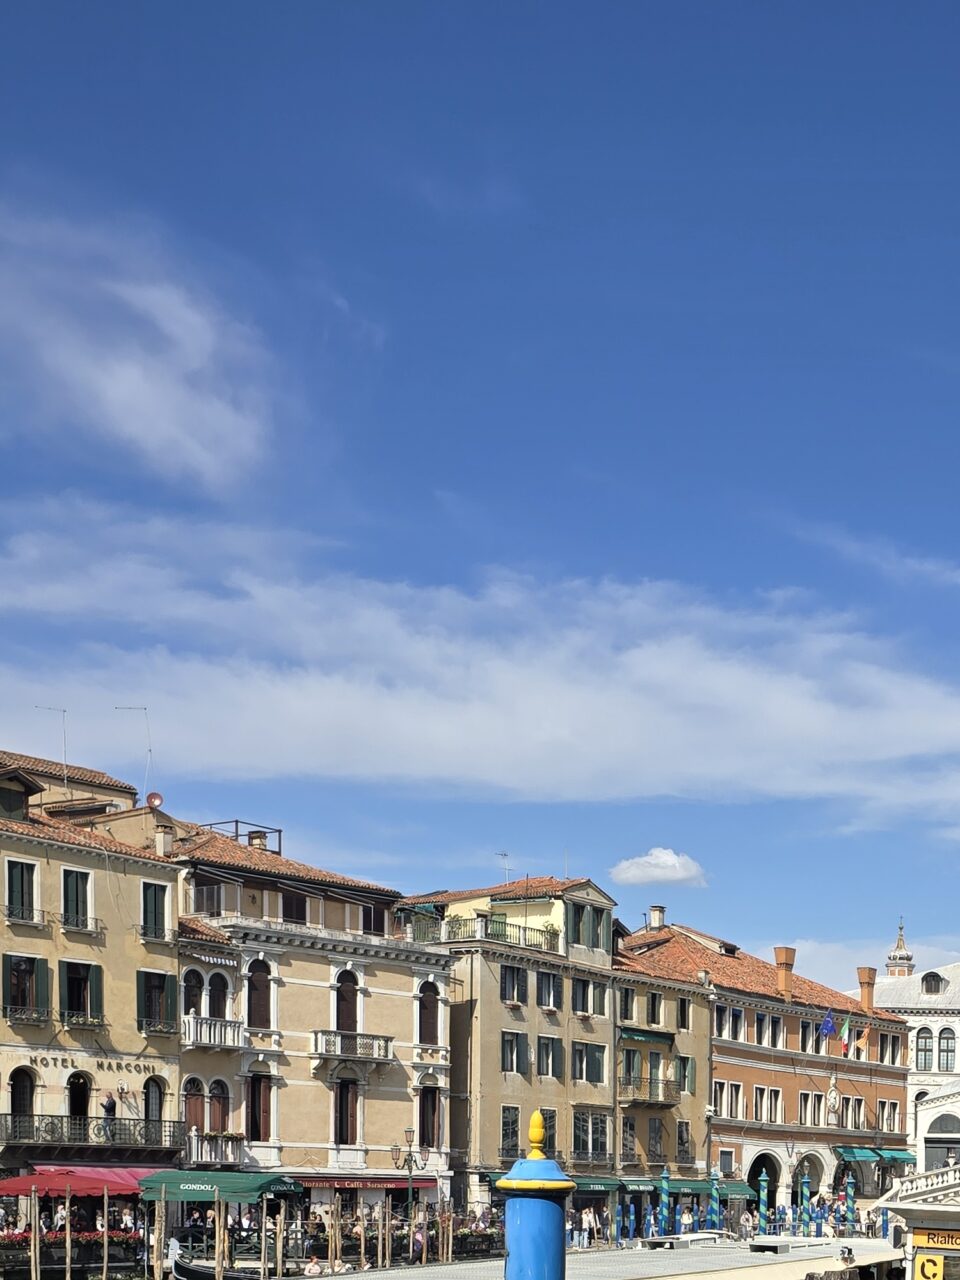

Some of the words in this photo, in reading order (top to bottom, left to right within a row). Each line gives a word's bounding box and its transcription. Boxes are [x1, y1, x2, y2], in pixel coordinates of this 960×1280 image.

[29, 1056, 79, 1069] HOTEL
[96, 1061, 156, 1074] MARCONI
[920, 1258, 938, 1280] C
